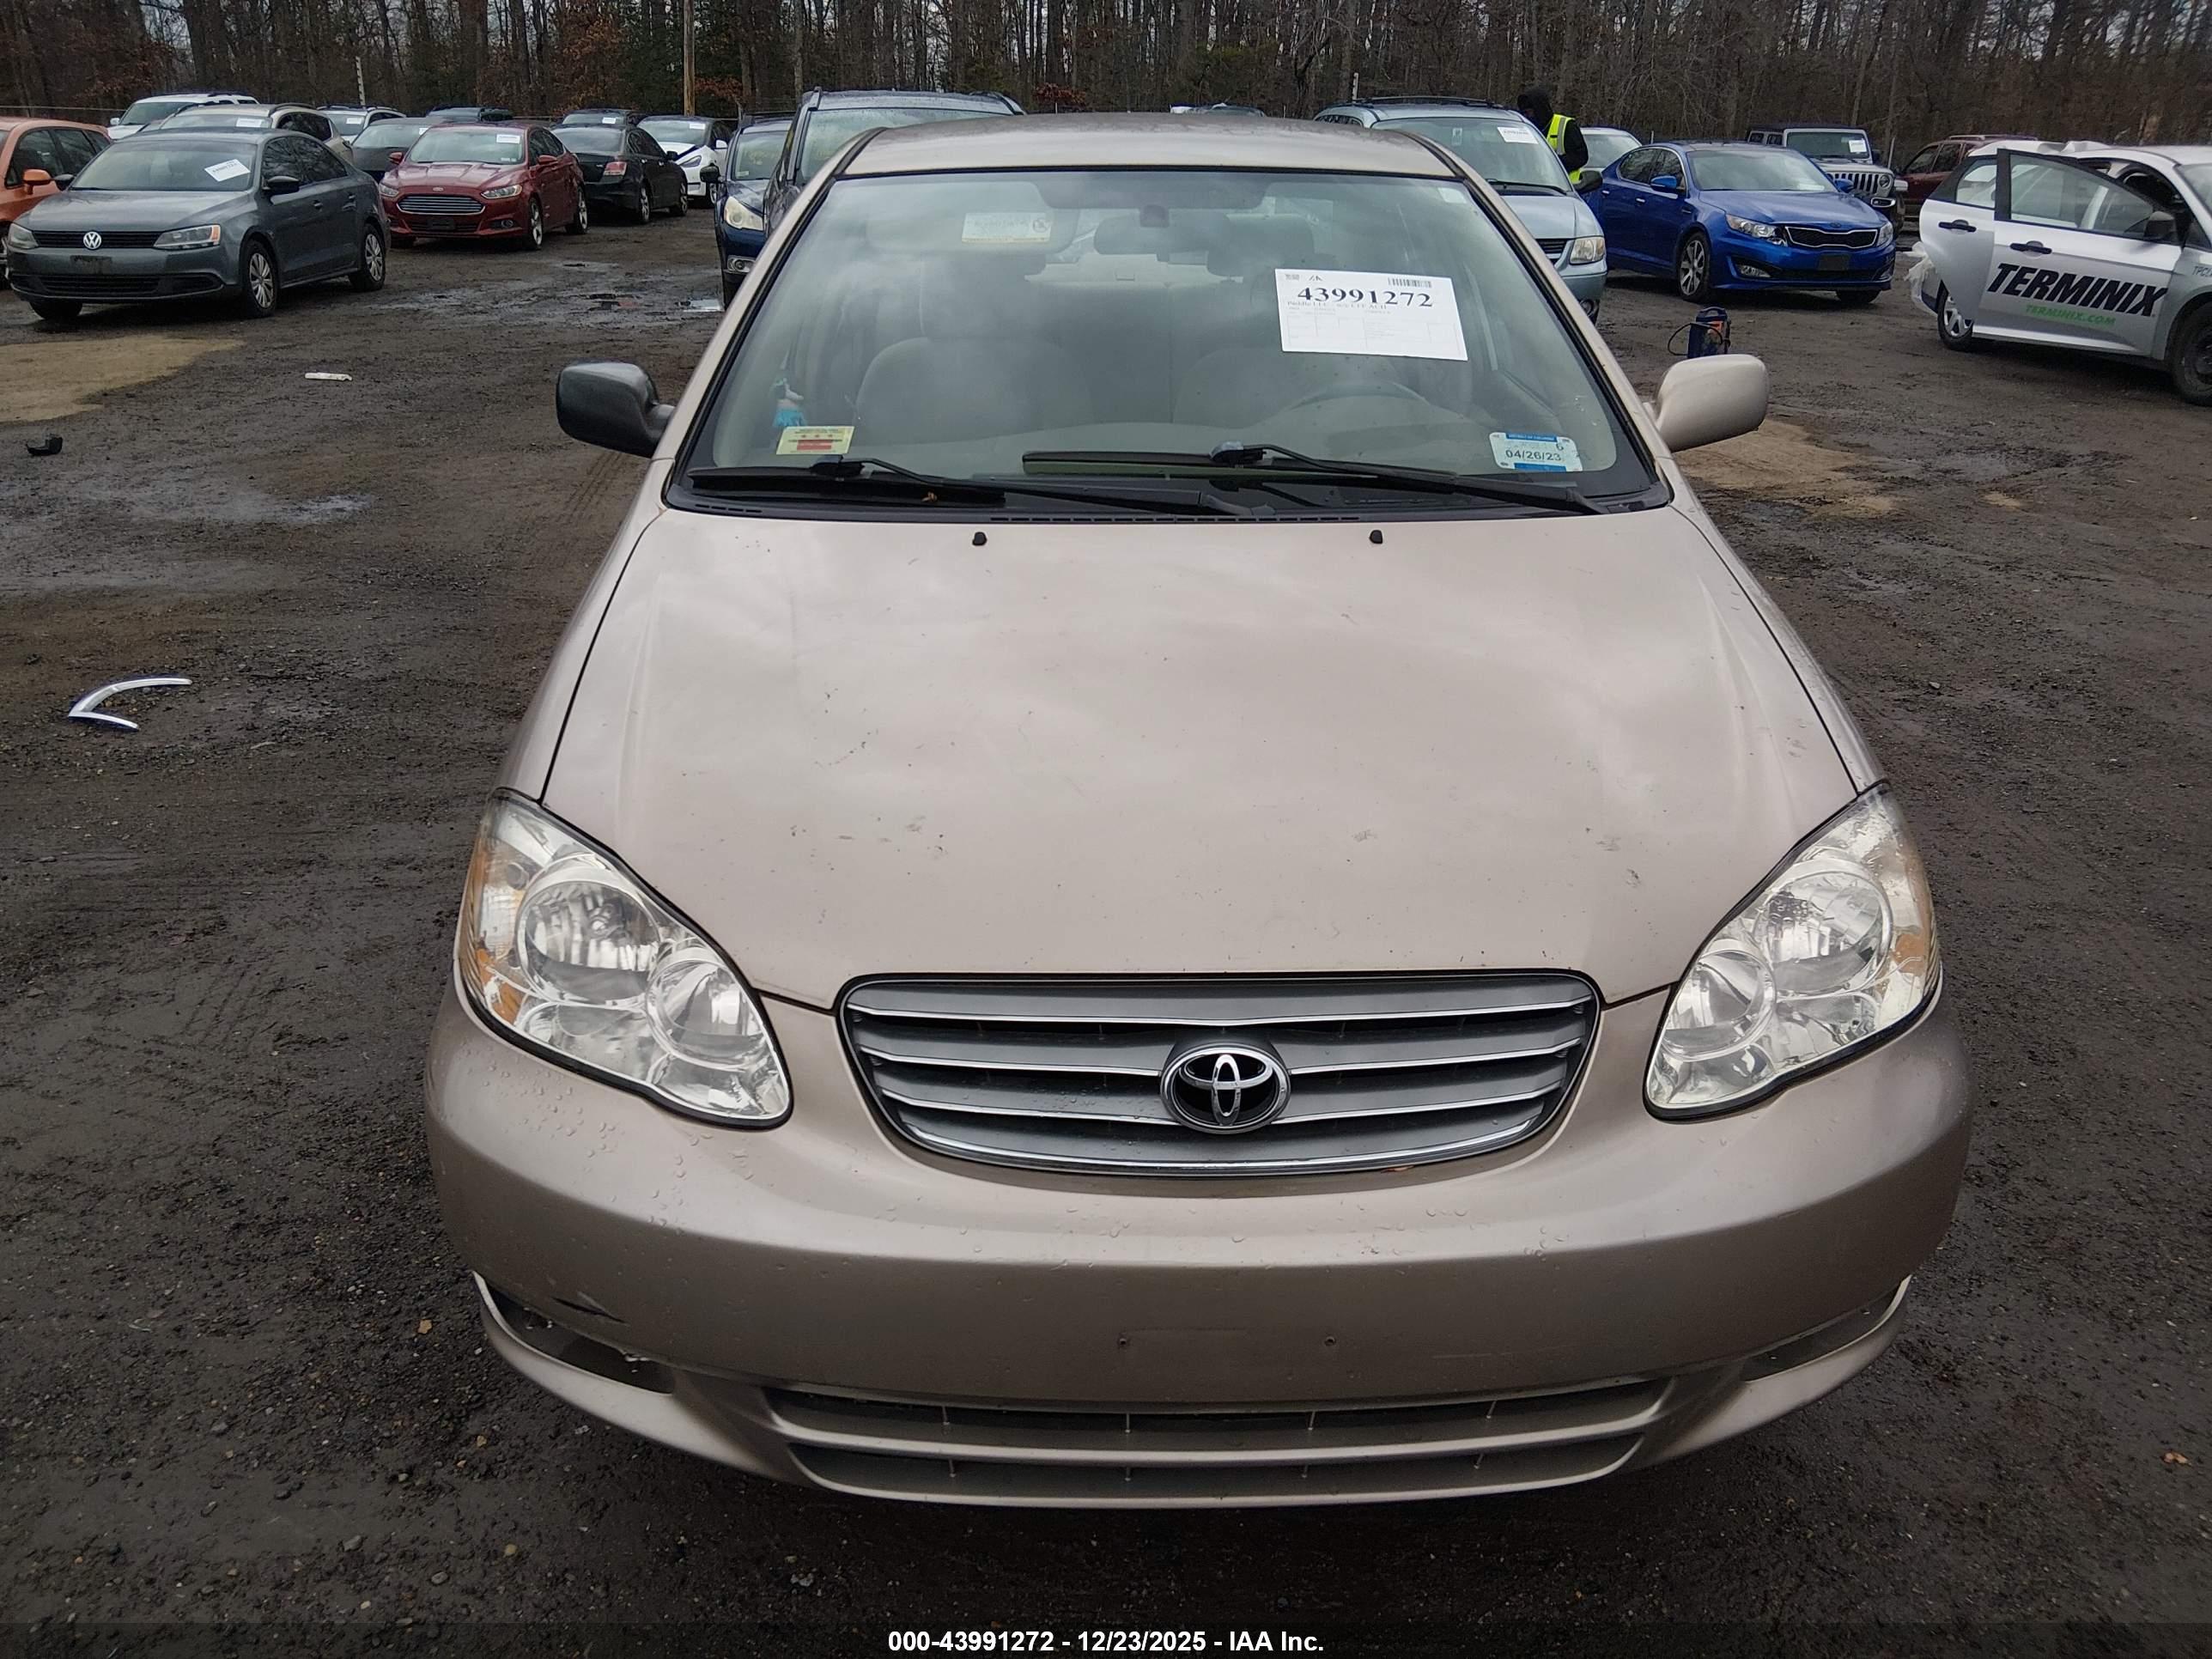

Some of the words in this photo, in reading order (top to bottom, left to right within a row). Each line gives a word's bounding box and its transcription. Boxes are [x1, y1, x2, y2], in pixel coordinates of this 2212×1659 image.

[1297, 287, 1433, 307] 43991272
[1986, 263, 2169, 317] TERMINIX
[2026, 304, 2118, 326] TERMINIX.COM
[1505, 449, 1562, 461] 04/26/23
